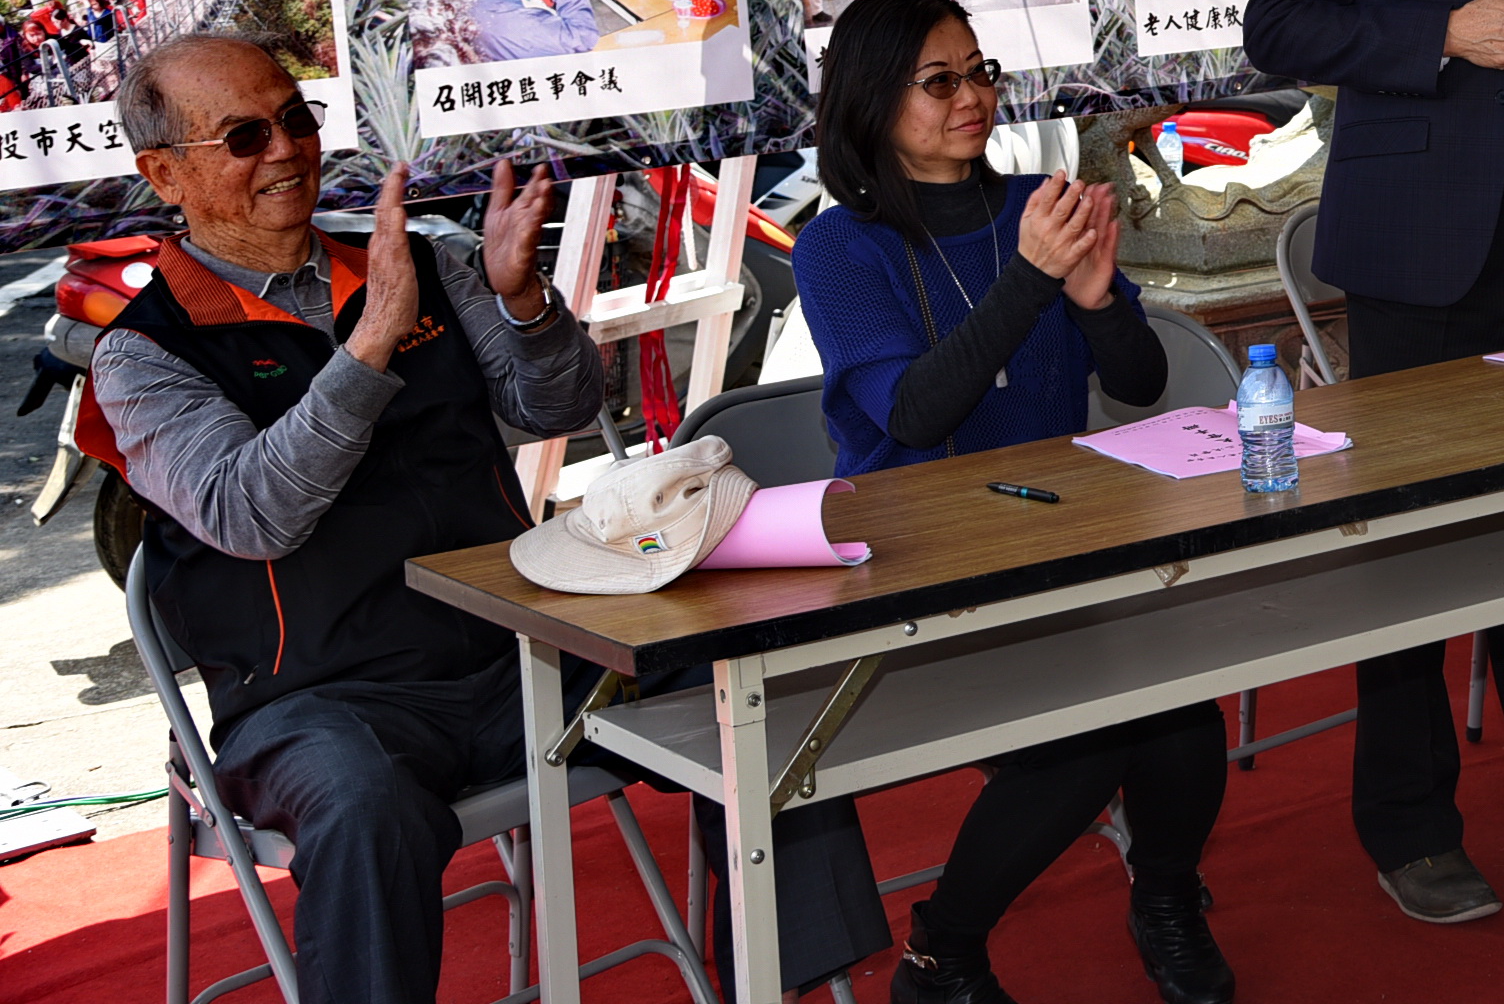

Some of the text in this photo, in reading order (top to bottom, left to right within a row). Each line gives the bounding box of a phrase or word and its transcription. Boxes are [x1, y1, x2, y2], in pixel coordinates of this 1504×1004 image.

[1143, 5, 1244, 37] 老人健康飲
[432, 67, 623, 113] 召開理監事會議
[1258, 414, 1279, 425] EYES
